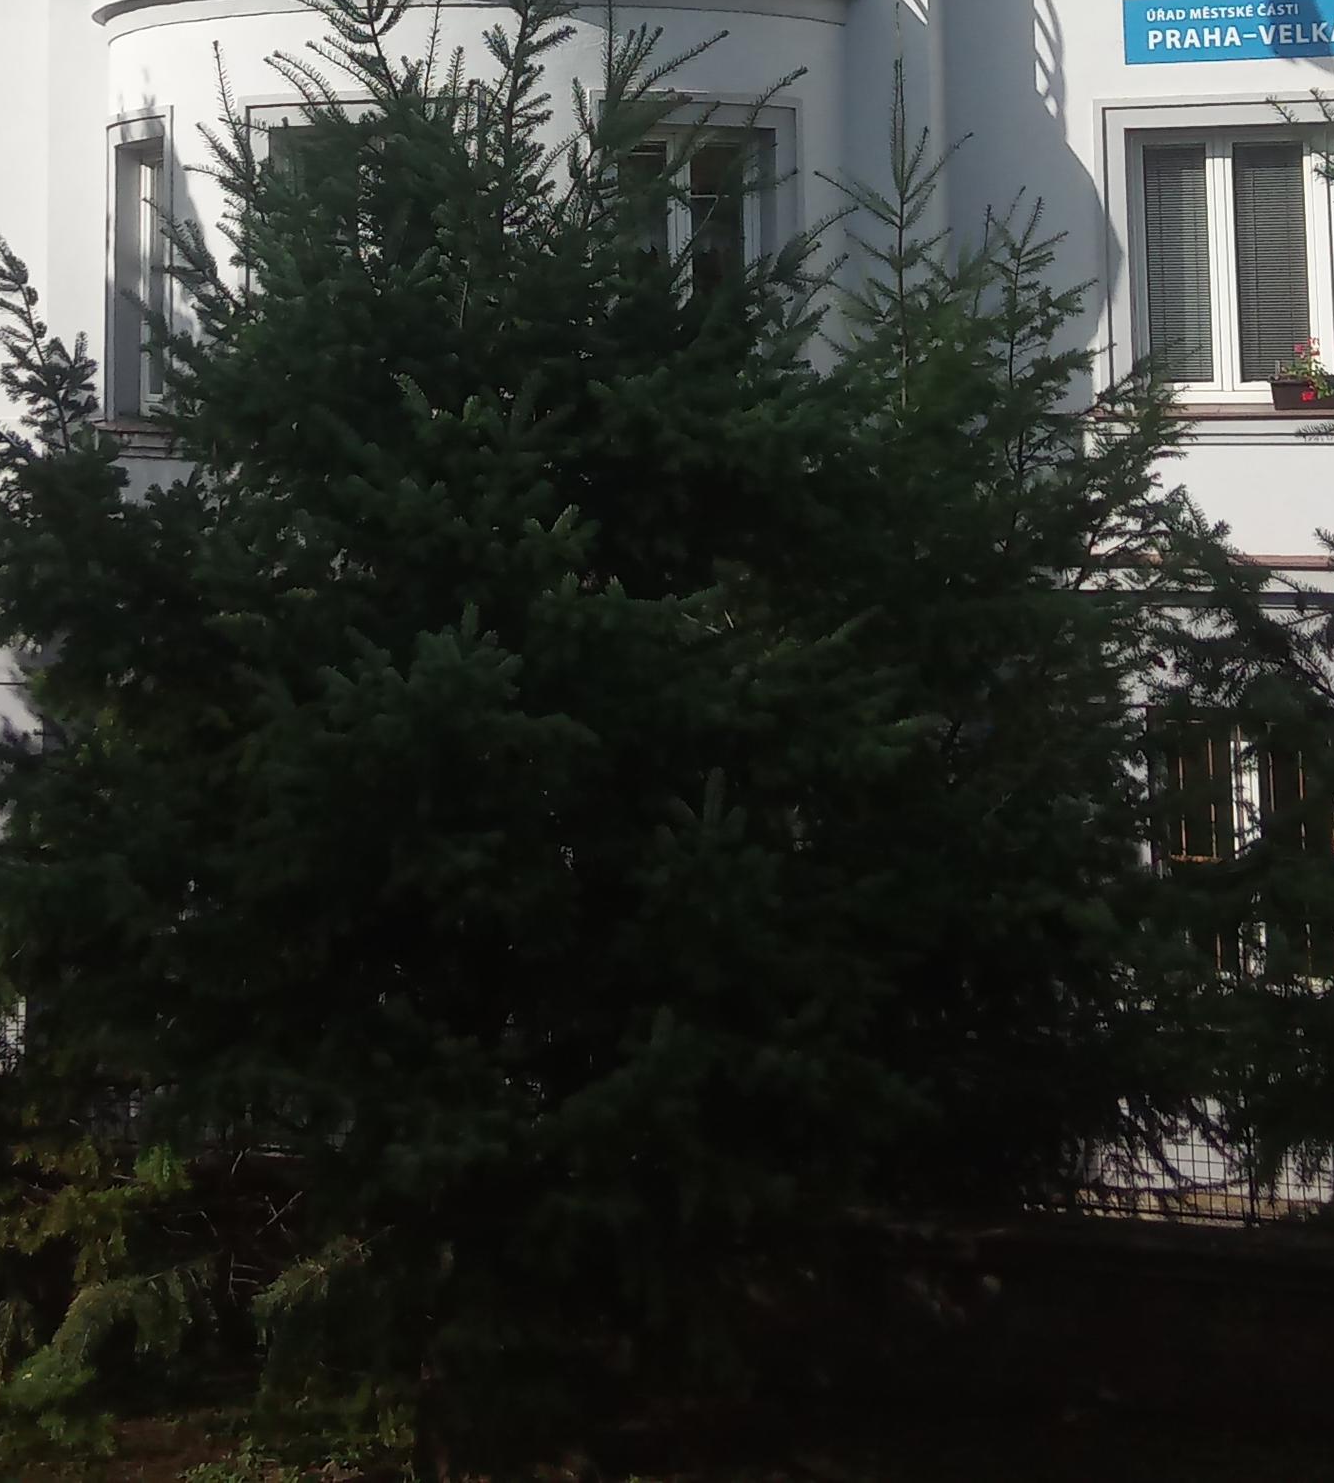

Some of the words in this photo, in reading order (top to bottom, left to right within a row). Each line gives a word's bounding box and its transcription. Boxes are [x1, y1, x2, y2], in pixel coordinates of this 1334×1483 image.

[1146, 7, 1186, 22] ÚŘAD
[1190, 4, 1254, 20] MĚSTSKÉ
[1256, 2, 1300, 19] ČÁSTI
